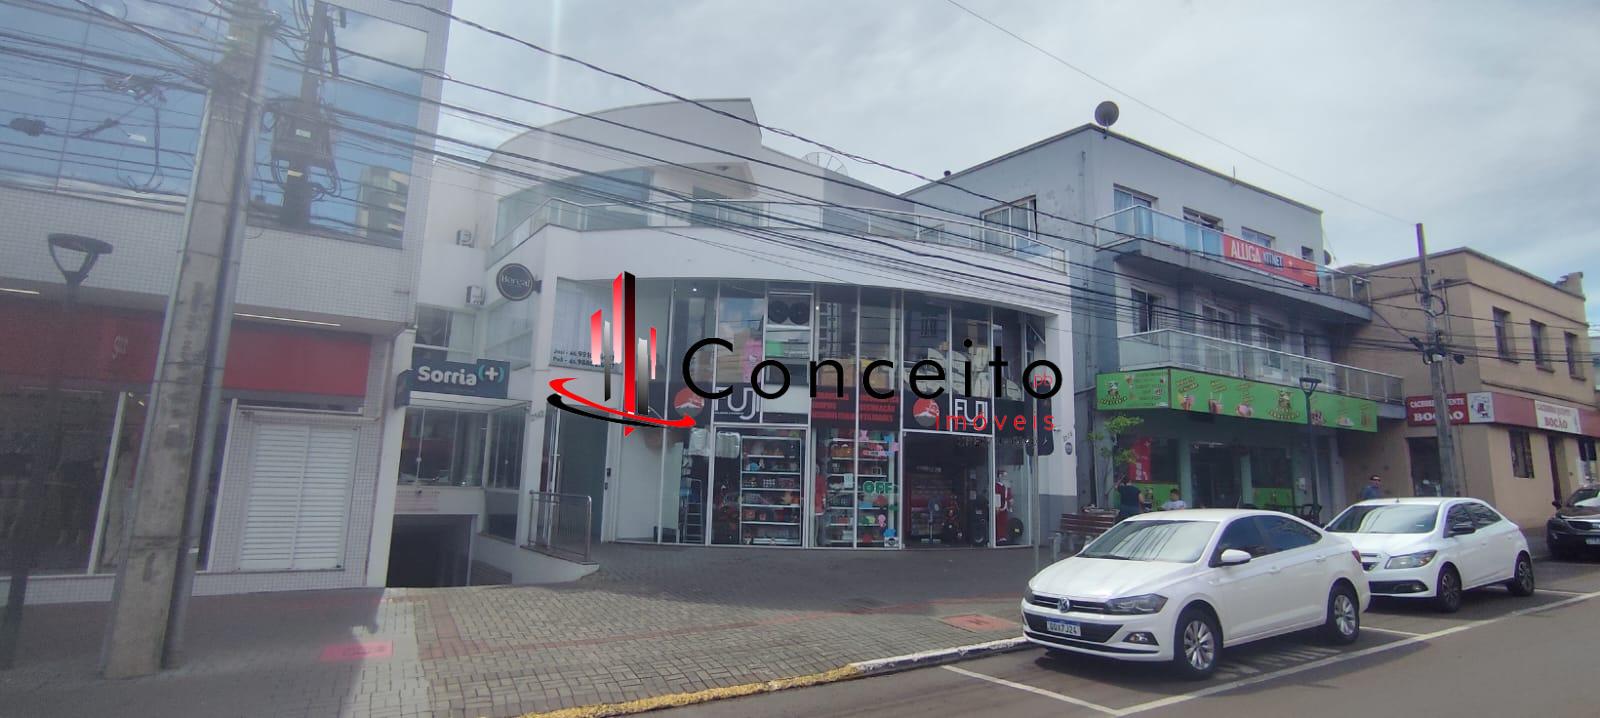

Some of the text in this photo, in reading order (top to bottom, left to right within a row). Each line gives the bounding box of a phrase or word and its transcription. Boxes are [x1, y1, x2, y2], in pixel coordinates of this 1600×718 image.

[1230, 239, 1261, 264] ALUGA
[417, 365, 478, 386] Sorria
[1413, 410, 1464, 422] BOO
